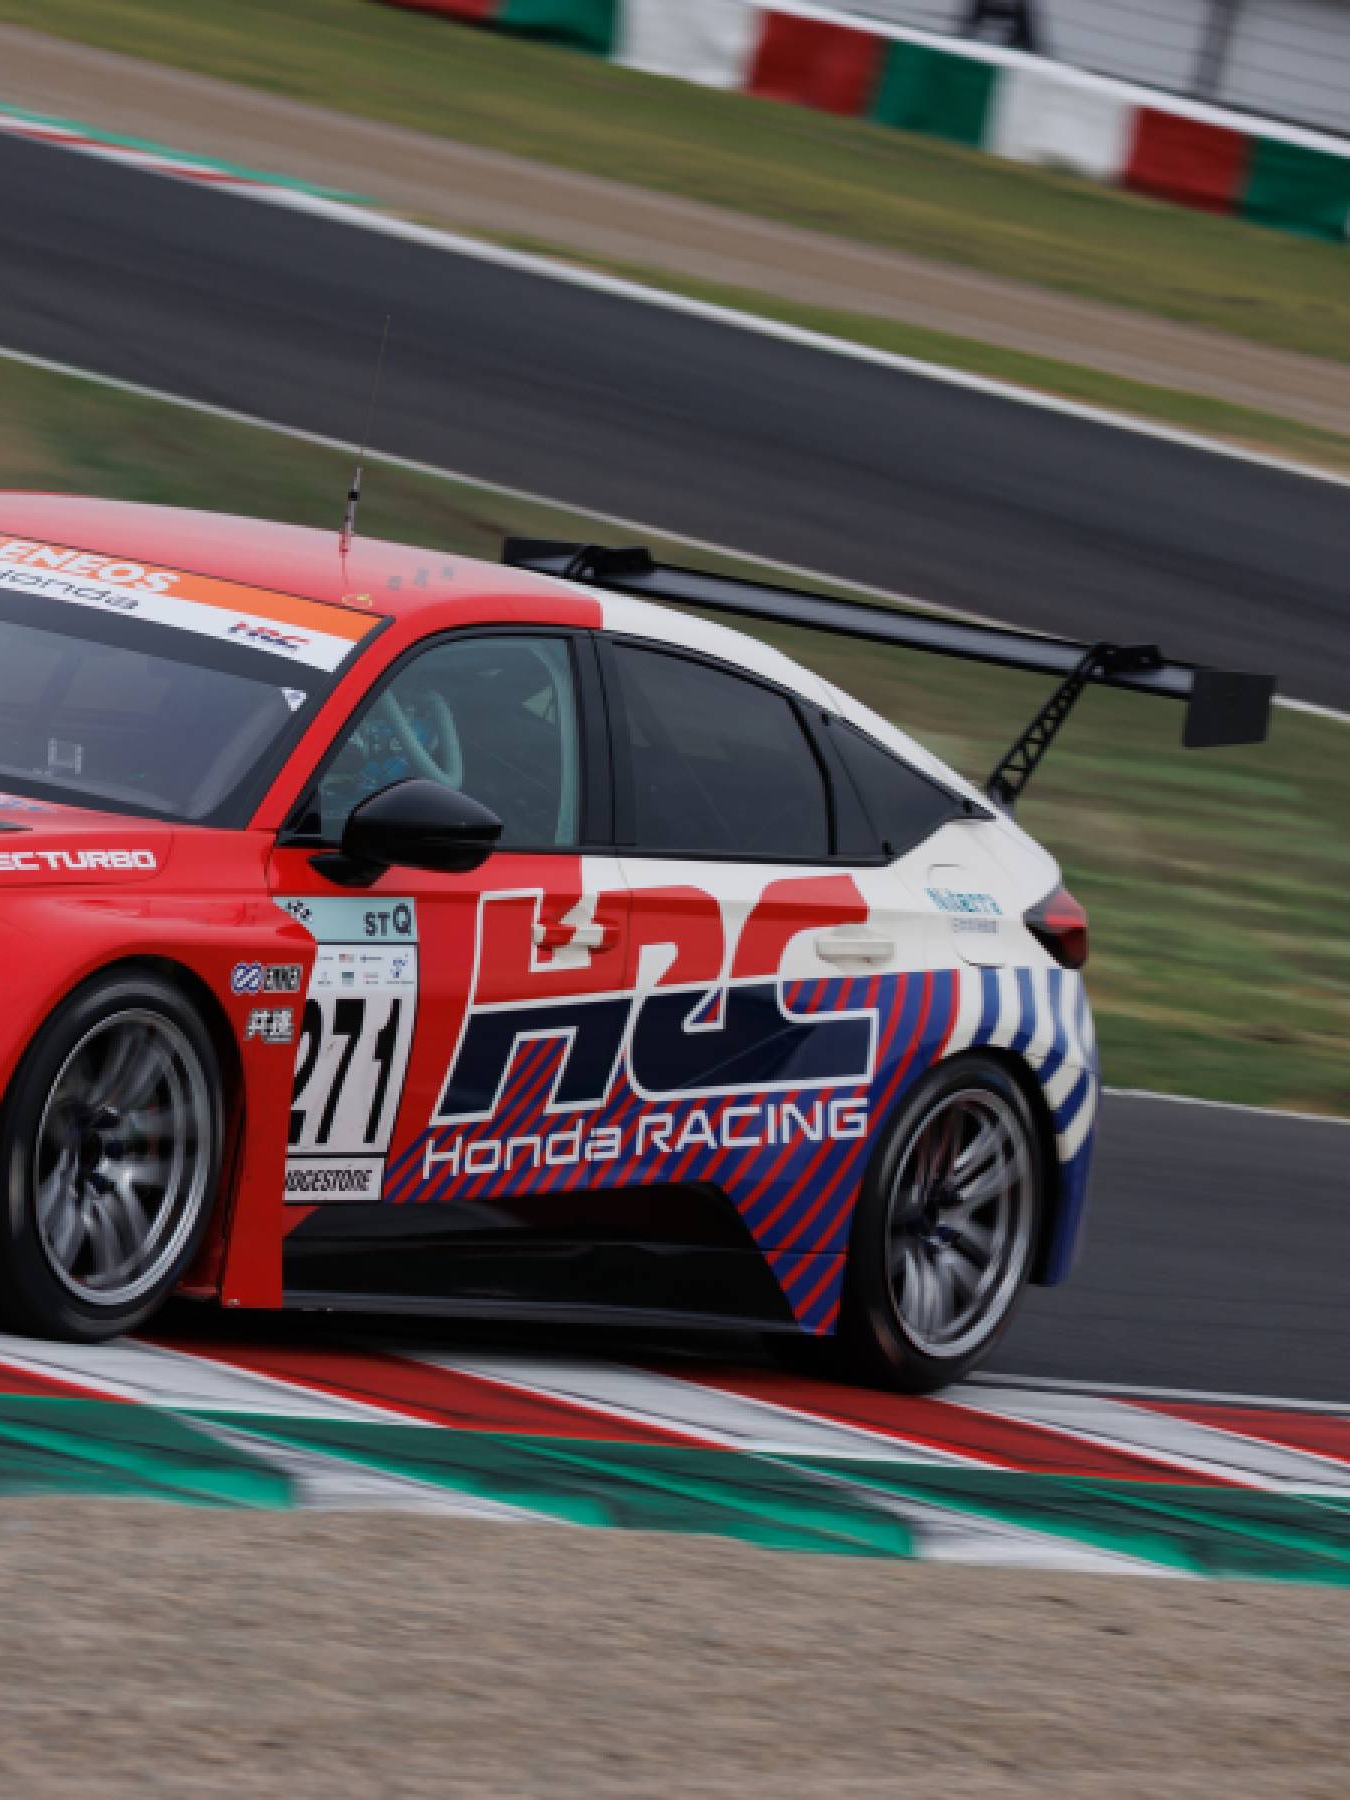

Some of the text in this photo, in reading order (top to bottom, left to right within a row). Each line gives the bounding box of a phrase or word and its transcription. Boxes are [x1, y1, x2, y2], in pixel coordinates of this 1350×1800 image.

[228, 620, 310, 651] HRC
[36, 849, 157, 871] TURBO
[430, 873, 879, 1126] HRC
[422, 1098, 871, 1180] Honda RACING
[285, 1169, 373, 1192] IDGESTONE
